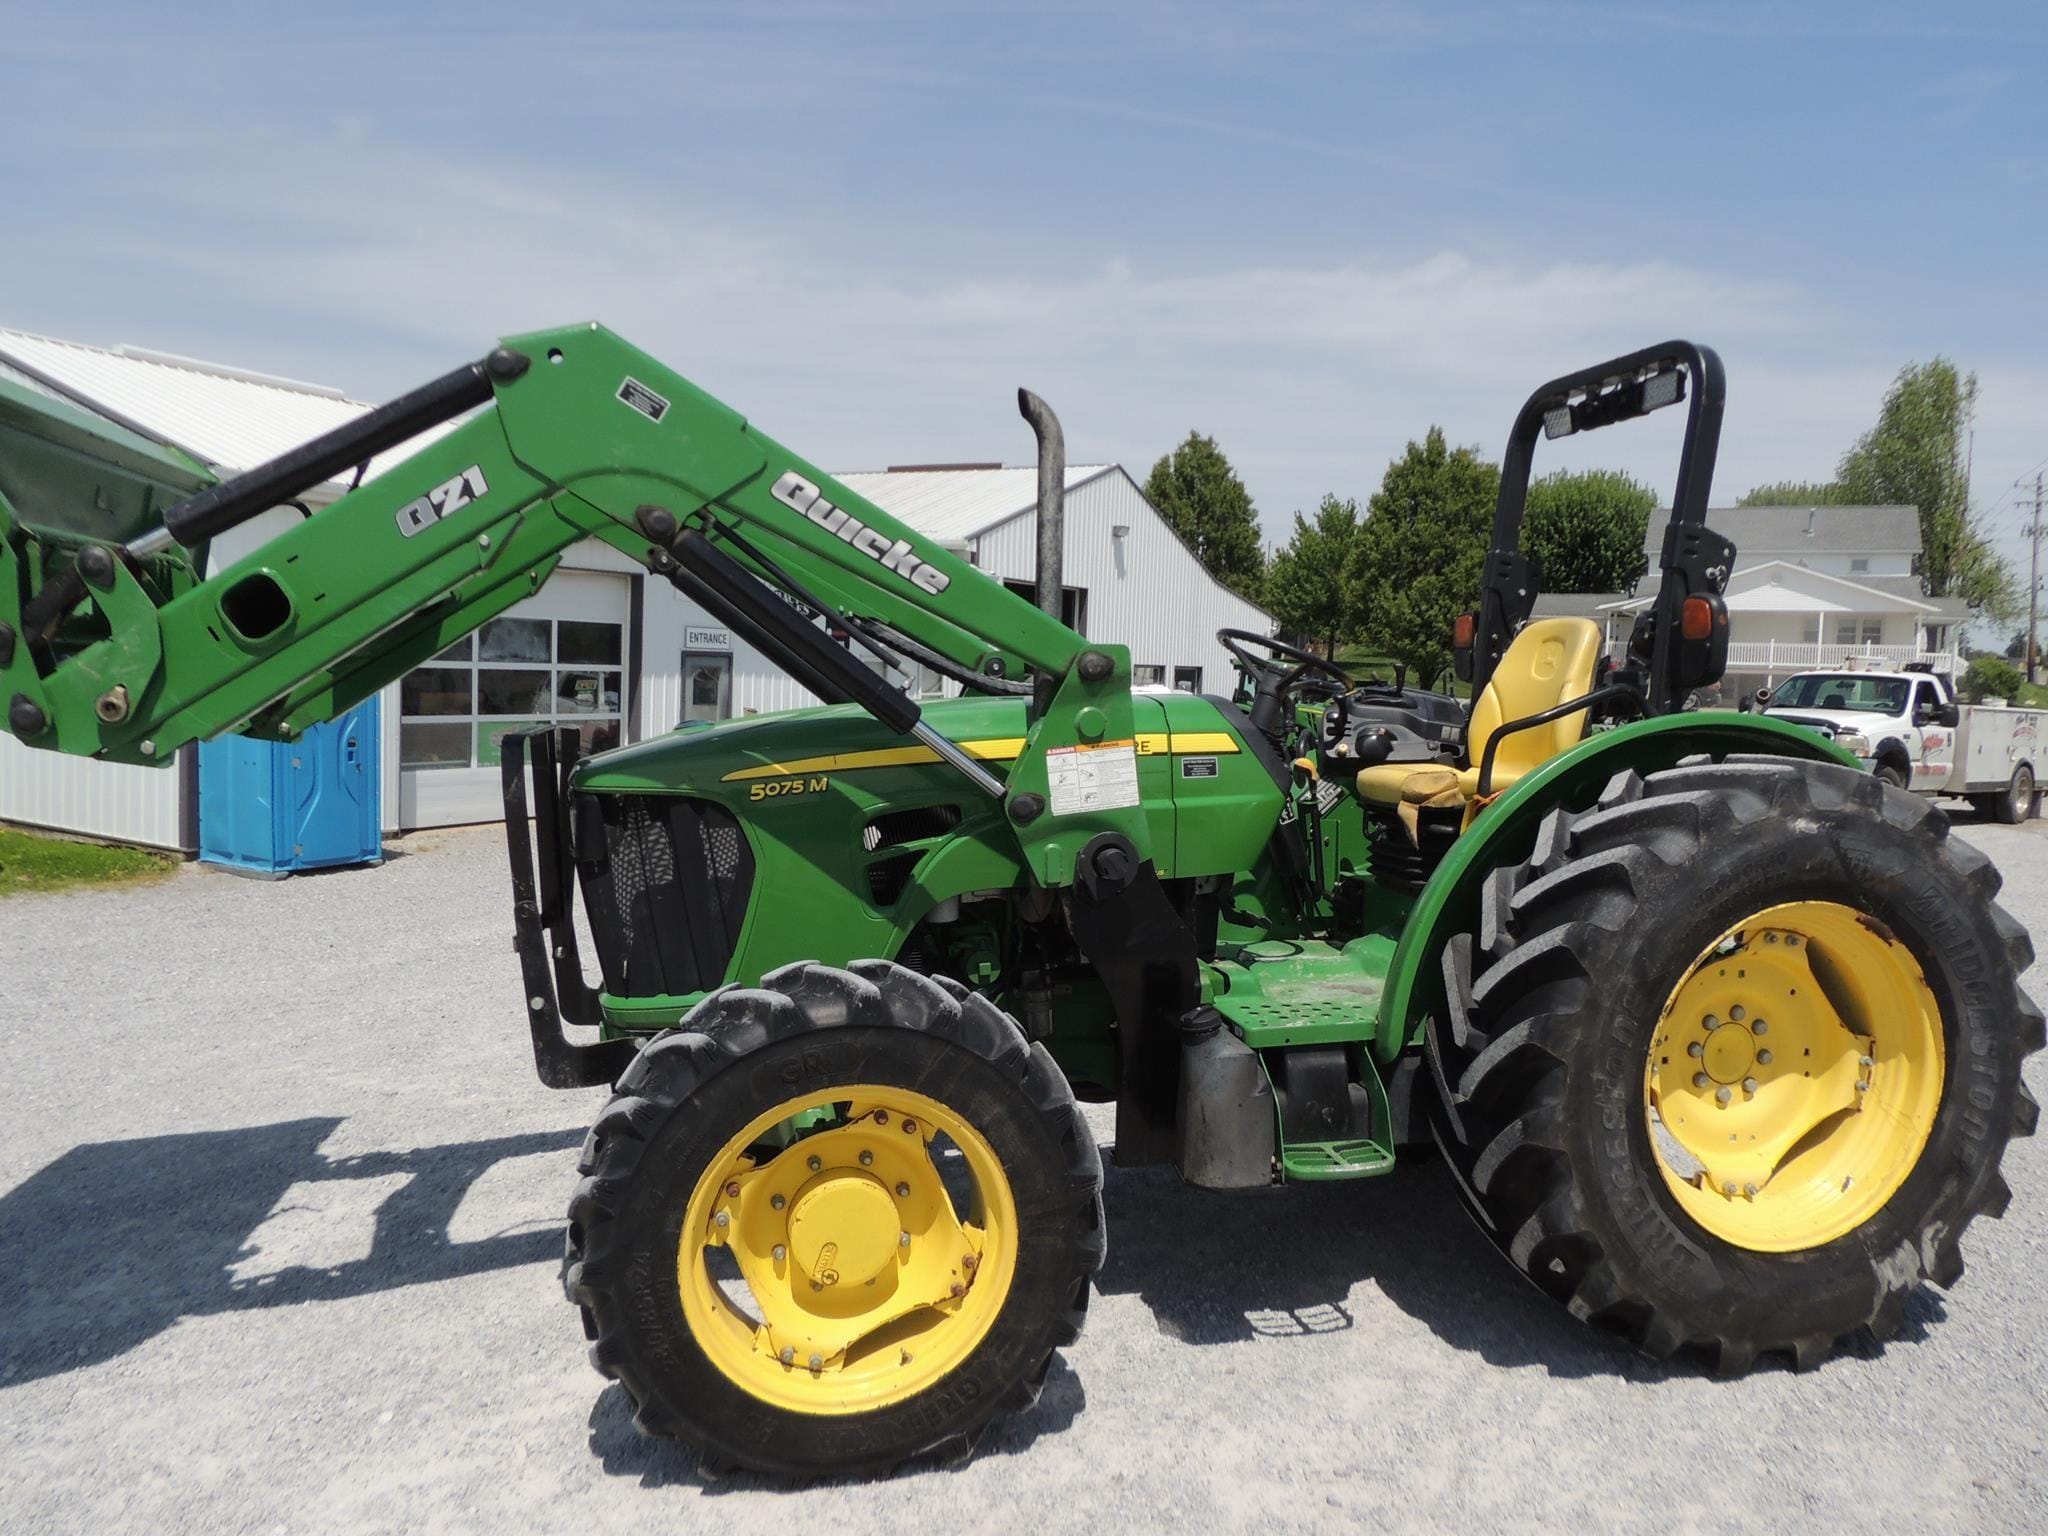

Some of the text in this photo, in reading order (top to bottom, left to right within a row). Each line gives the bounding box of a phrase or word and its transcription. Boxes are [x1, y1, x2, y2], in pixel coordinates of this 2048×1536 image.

[770, 470, 951, 596] Quicke
[689, 631, 728, 645] ENTRANCE
[750, 777, 829, 801] 5075 M
